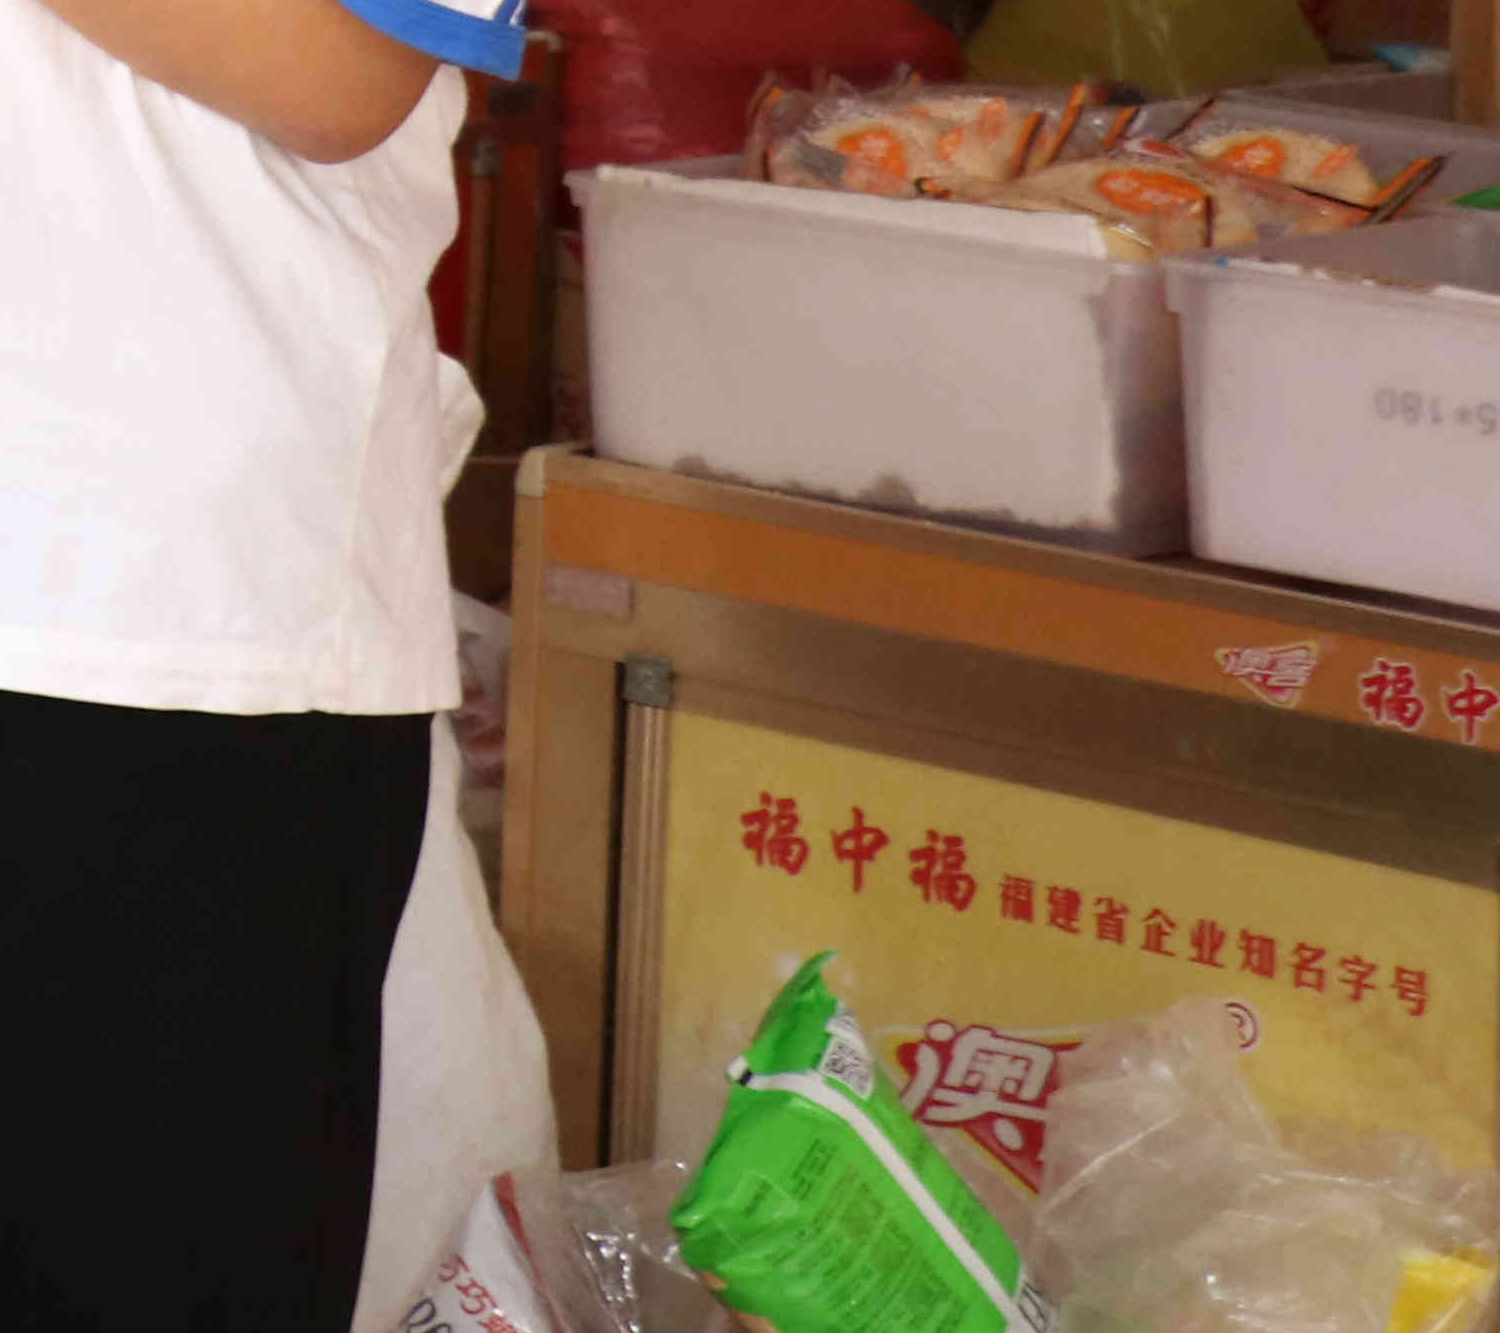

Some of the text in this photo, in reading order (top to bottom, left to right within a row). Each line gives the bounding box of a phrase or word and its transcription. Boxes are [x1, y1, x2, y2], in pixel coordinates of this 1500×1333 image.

[741, 790, 977, 913] 福中福
[998, 871, 1432, 1017] 福建省企业知名字号
